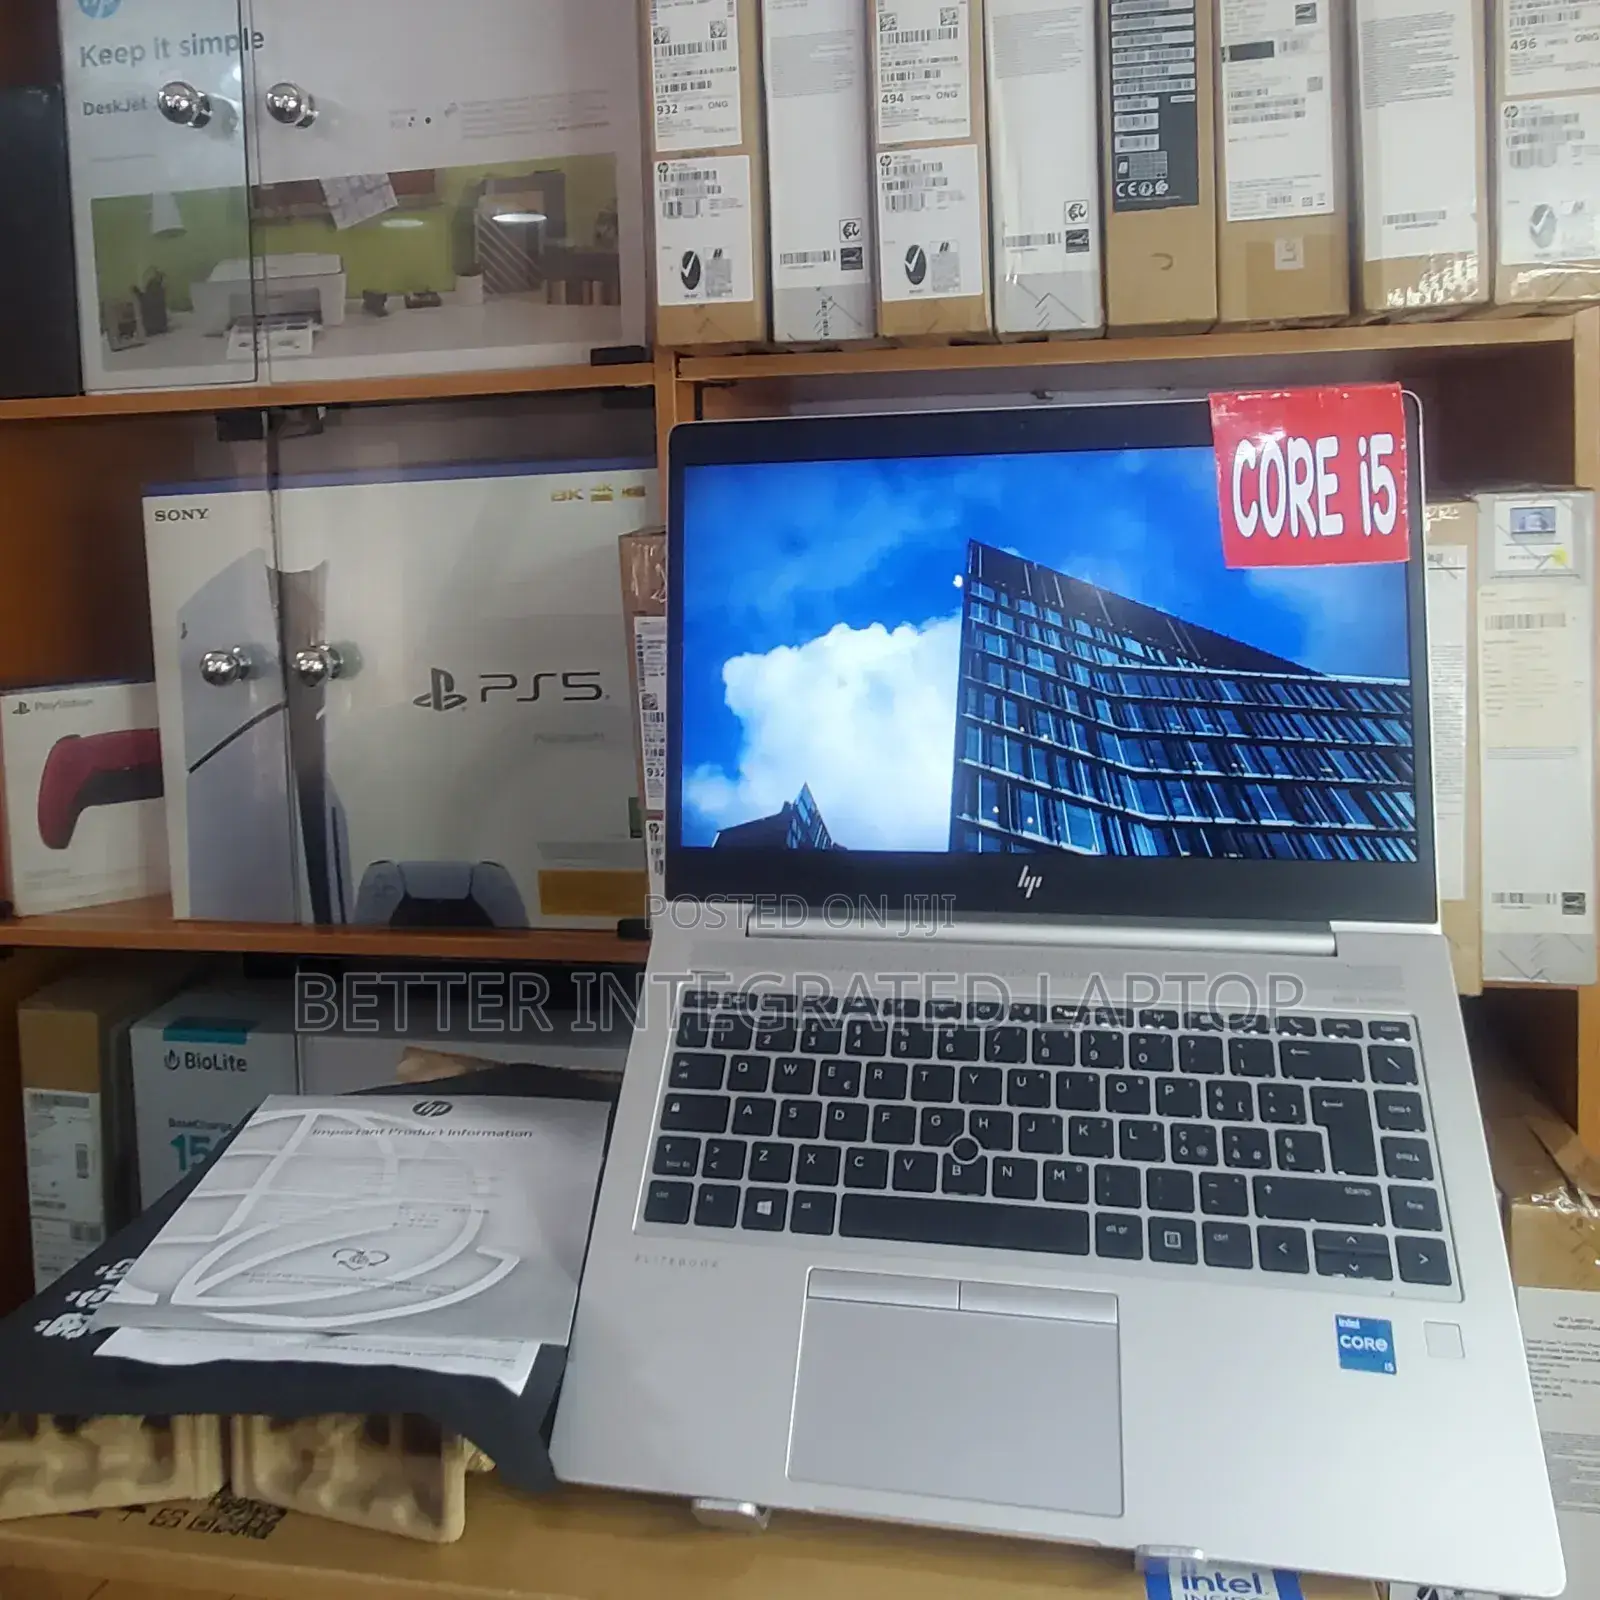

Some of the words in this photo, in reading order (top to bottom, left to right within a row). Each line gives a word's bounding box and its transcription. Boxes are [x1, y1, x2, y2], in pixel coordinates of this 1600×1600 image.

[80, 44, 146, 67] Keep
[154, 37, 170, 60] it
[179, 28, 265, 57] simple
[1510, 38, 1537, 50] 496
[881, 93, 904, 104] 494
[83, 98, 147, 116] DeskJet
[657, 104, 678, 115] 932
[1232, 436, 1344, 538] CORE
[1358, 433, 1397, 537] i5
[155, 508, 209, 522] SONY
[479, 672, 602, 702] PS5
[1017, 865, 1043, 898] hp
[764, 1035, 771, 1044] 2
[808, 1037, 816, 1046] 3
[1090, 1050, 1098, 1060] 9
[184, 1051, 248, 1072] BioLite
[783, 1064, 797, 1075] W
[827, 1066, 836, 1076] E
[874, 1068, 883, 1079] R
[921, 1071, 929, 1081] T
[970, 1073, 979, 1084] Y
[1017, 1076, 1027, 1087] U
[1115, 1081, 1127, 1093] O
[1165, 1084, 1174, 1095] P
[412, 1100, 453, 1117] hp
[742, 1105, 752, 1115] A
[789, 1108, 797, 1118] S
[835, 1109, 845, 1120] D
[882, 1112, 890, 1122] F
[931, 1115, 941, 1126] G
[978, 1118, 988, 1129] H
[1027, 1121, 1036, 1132] J
[1079, 1124, 1088, 1136] K
[313, 1127, 384, 1138] Important
[388, 1127, 443, 1137] Product
[448, 1128, 533, 1139] Information
[1129, 1128, 1138, 1140] L
[759, 1150, 768, 1162] Z
[806, 1153, 816, 1164] X
[854, 1156, 864, 1167] C
[903, 1158, 914, 1170] V
[952, 1165, 961, 1176] B
[1002, 1166, 1013, 1177] N
[1053, 1169, 1065, 1181] M
[1338, 1318, 1361, 1329] intel
[1181, 1566, 1263, 1594] intel
